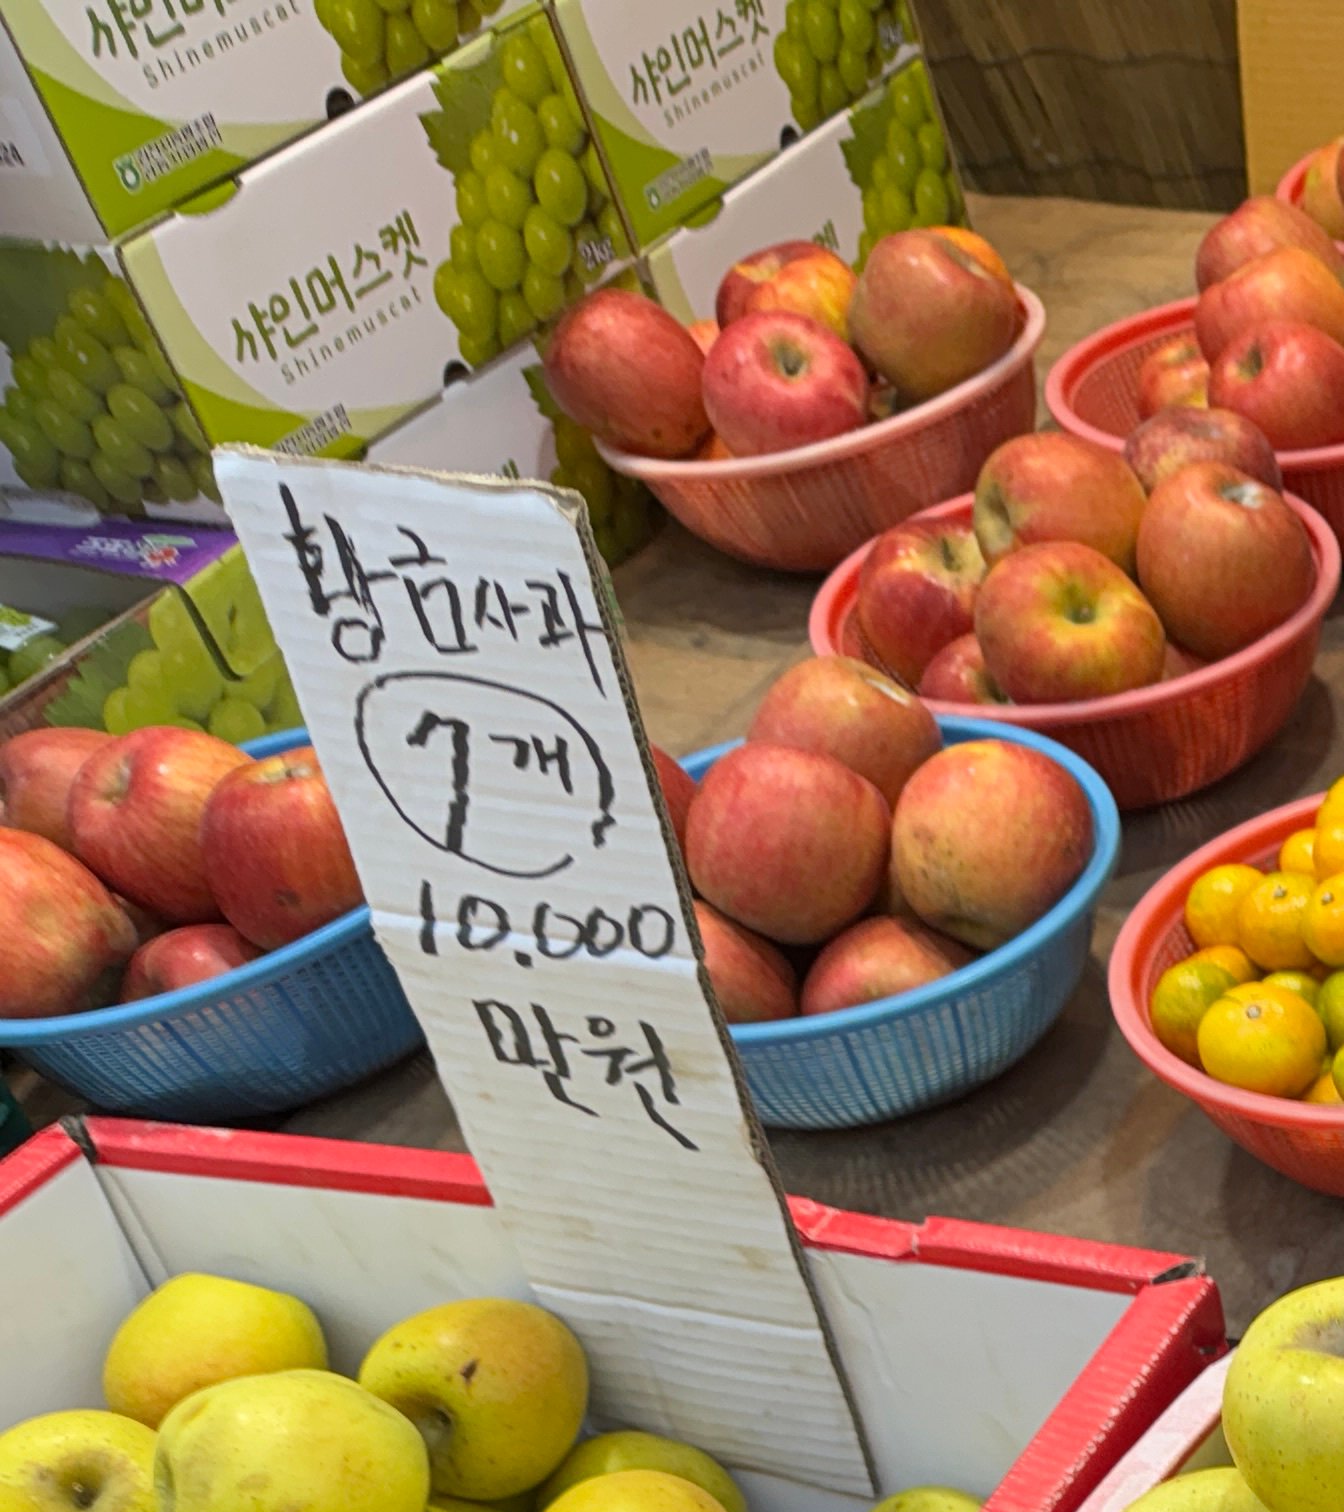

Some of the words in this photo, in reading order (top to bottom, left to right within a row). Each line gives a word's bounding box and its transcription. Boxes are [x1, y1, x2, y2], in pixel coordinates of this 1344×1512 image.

[142, 0, 300, 89] Shinemuscat
[629, 0, 770, 105] 샤인머스켓
[663, 51, 766, 128] Shinemuscat
[231, 209, 429, 364] 샤인머스켓
[280, 285, 424, 385] Shinemuscat
[278, 484, 609, 698] 황금사과
[406, 712, 574, 853] 7개
[474, 1000, 699, 1151] 만원
